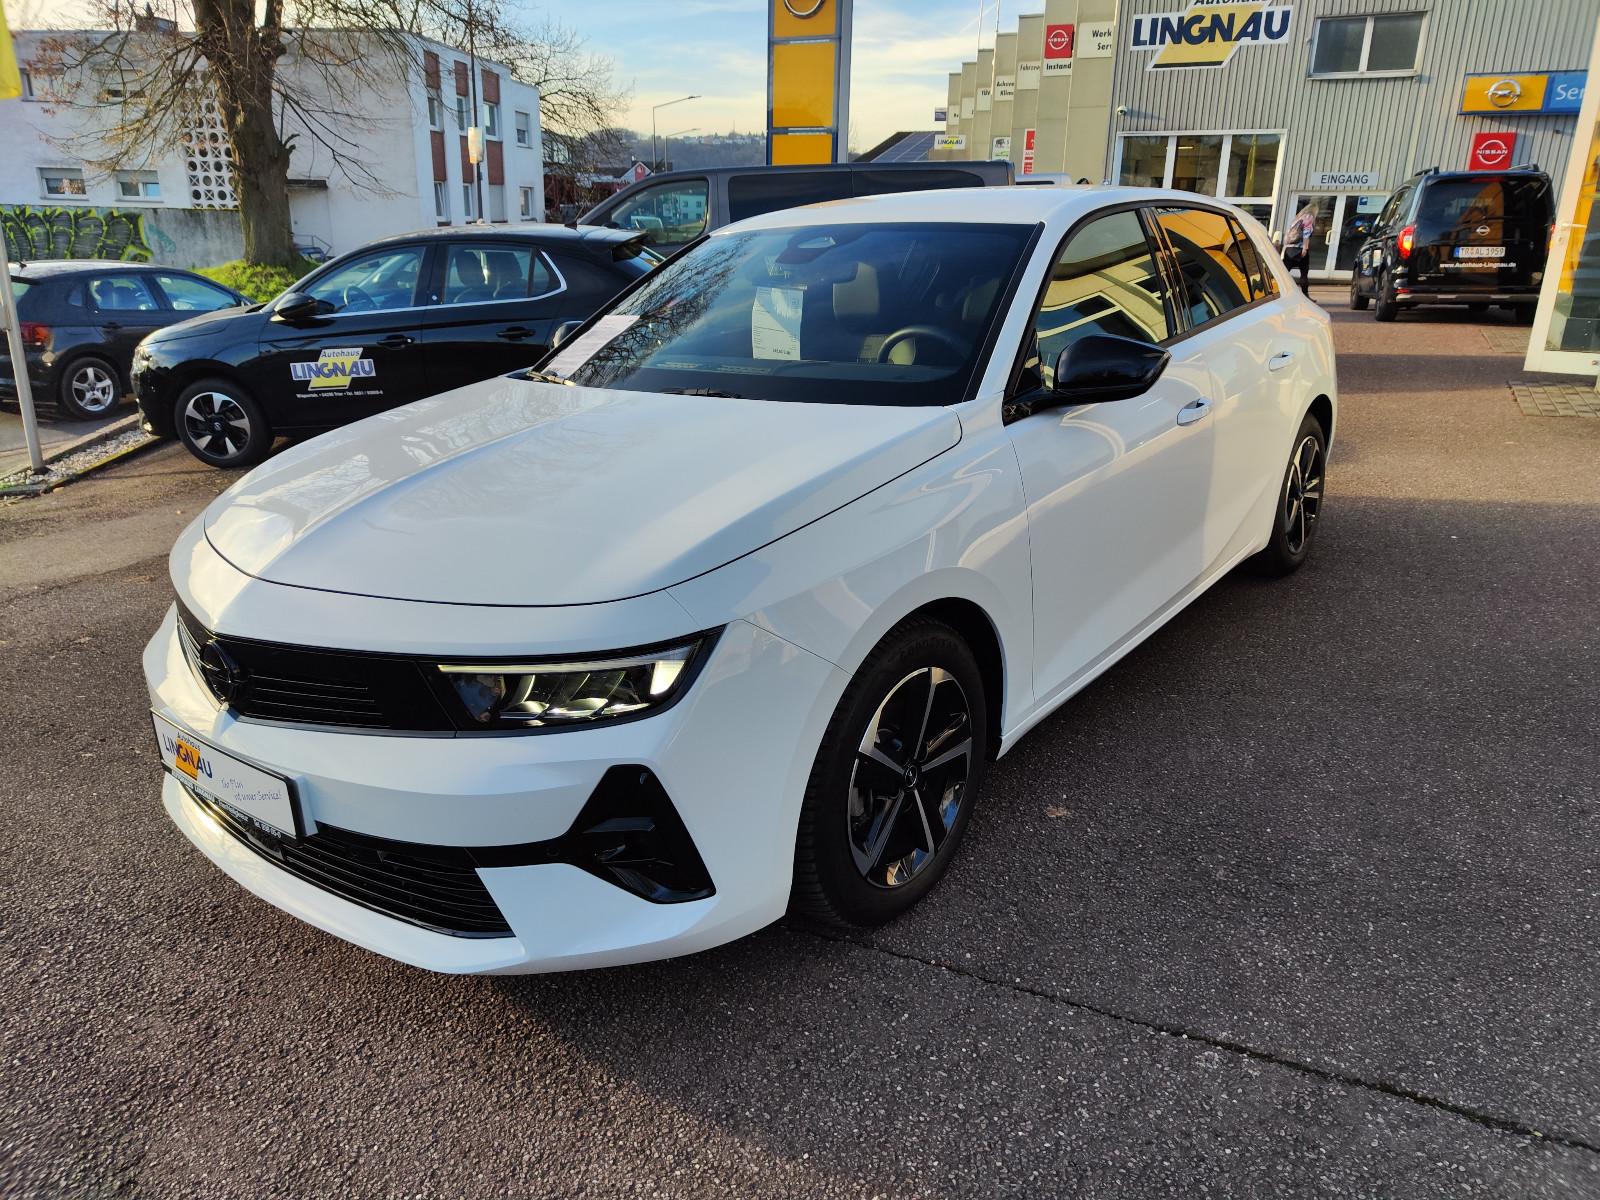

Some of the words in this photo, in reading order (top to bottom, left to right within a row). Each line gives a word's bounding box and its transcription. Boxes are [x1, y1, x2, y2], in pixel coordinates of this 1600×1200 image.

[1132, 10, 1290, 46] LINGNAU
[1046, 62, 1072, 70] Instand
[1320, 174, 1369, 184] EINGANG
[321, 350, 360, 358] Autohaus
[292, 361, 374, 379] LINGNAU
[162, 734, 213, 779] LINGNAU
